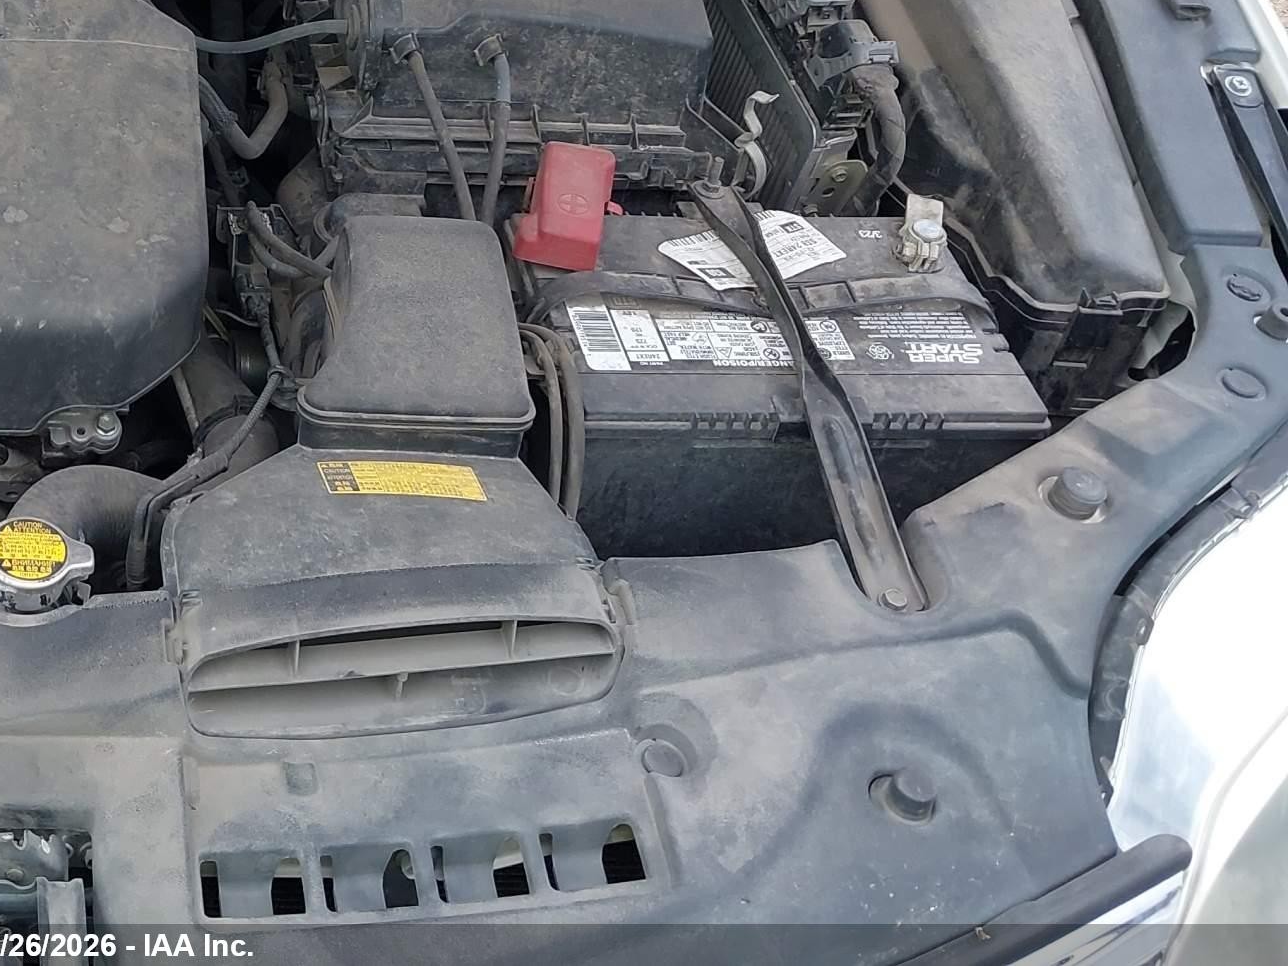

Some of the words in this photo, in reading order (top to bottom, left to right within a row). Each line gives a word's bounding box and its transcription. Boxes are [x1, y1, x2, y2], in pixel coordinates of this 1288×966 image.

[906, 343, 983, 355] START
[712, 360, 795, 368] ANGER/POISON
[908, 353, 980, 364] SUPER
